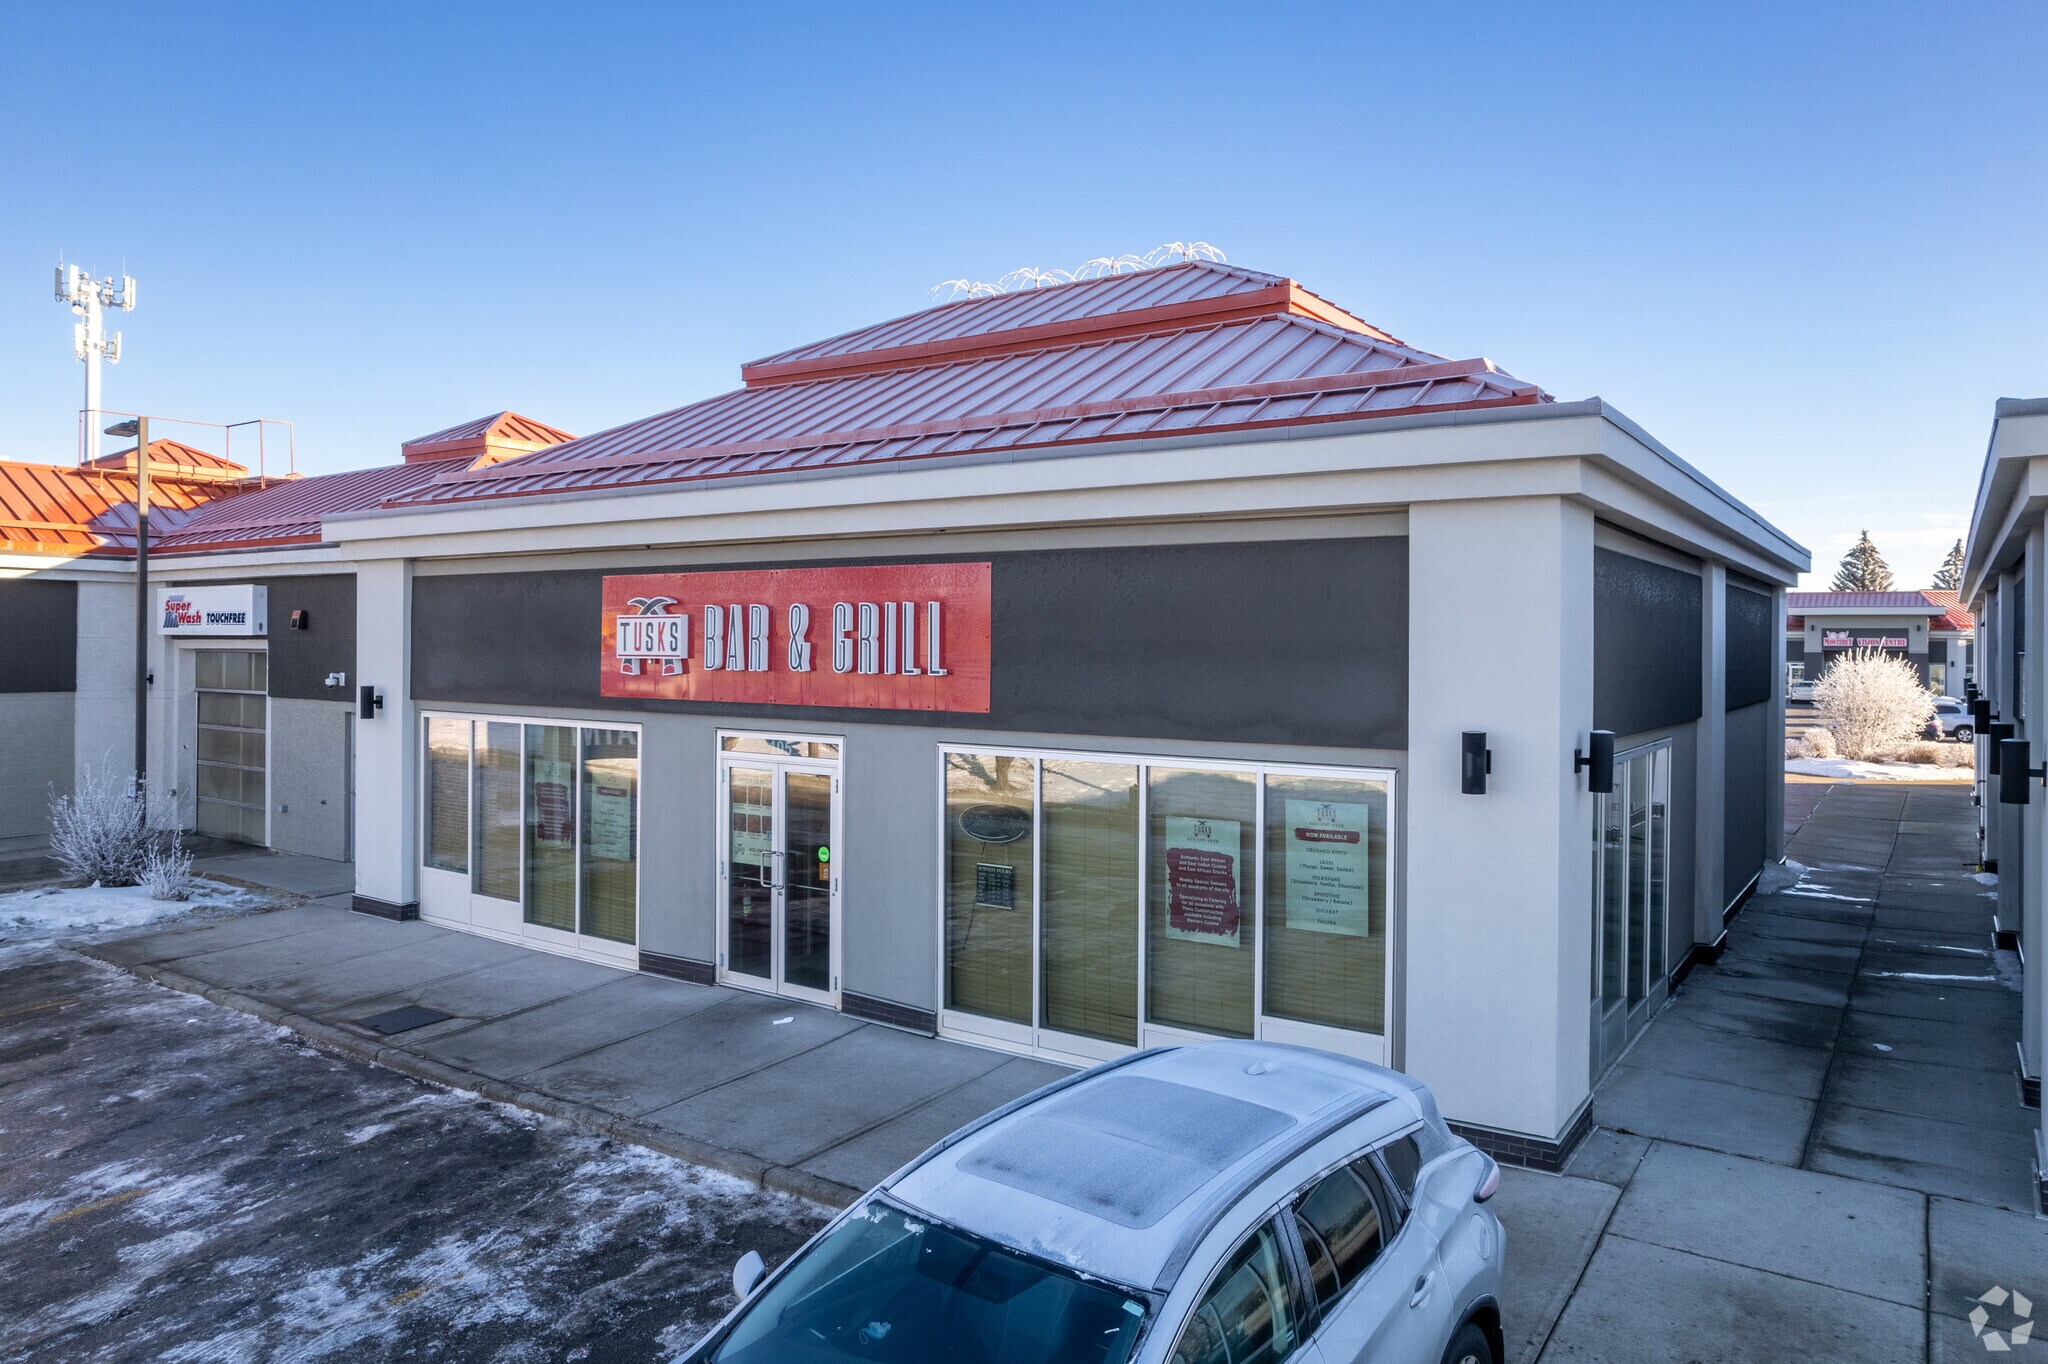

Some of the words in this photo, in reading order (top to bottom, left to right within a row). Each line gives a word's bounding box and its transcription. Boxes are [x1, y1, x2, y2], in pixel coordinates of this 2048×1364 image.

[165, 600, 191, 612] Super
[177, 610, 202, 624] Wash
[206, 612, 246, 624] TOUCHFREE
[620, 621, 680, 653] TUSKS
[704, 604, 769, 672] BAR
[788, 603, 811, 672] &
[832, 601, 948, 676] GRILL
[1858, 638, 1880, 646] VISION
[1881, 638, 1906, 646] ENTRE
[1302, 896, 1328, 904] (Strawberry
[1195, 907, 1224, 915] Customization
